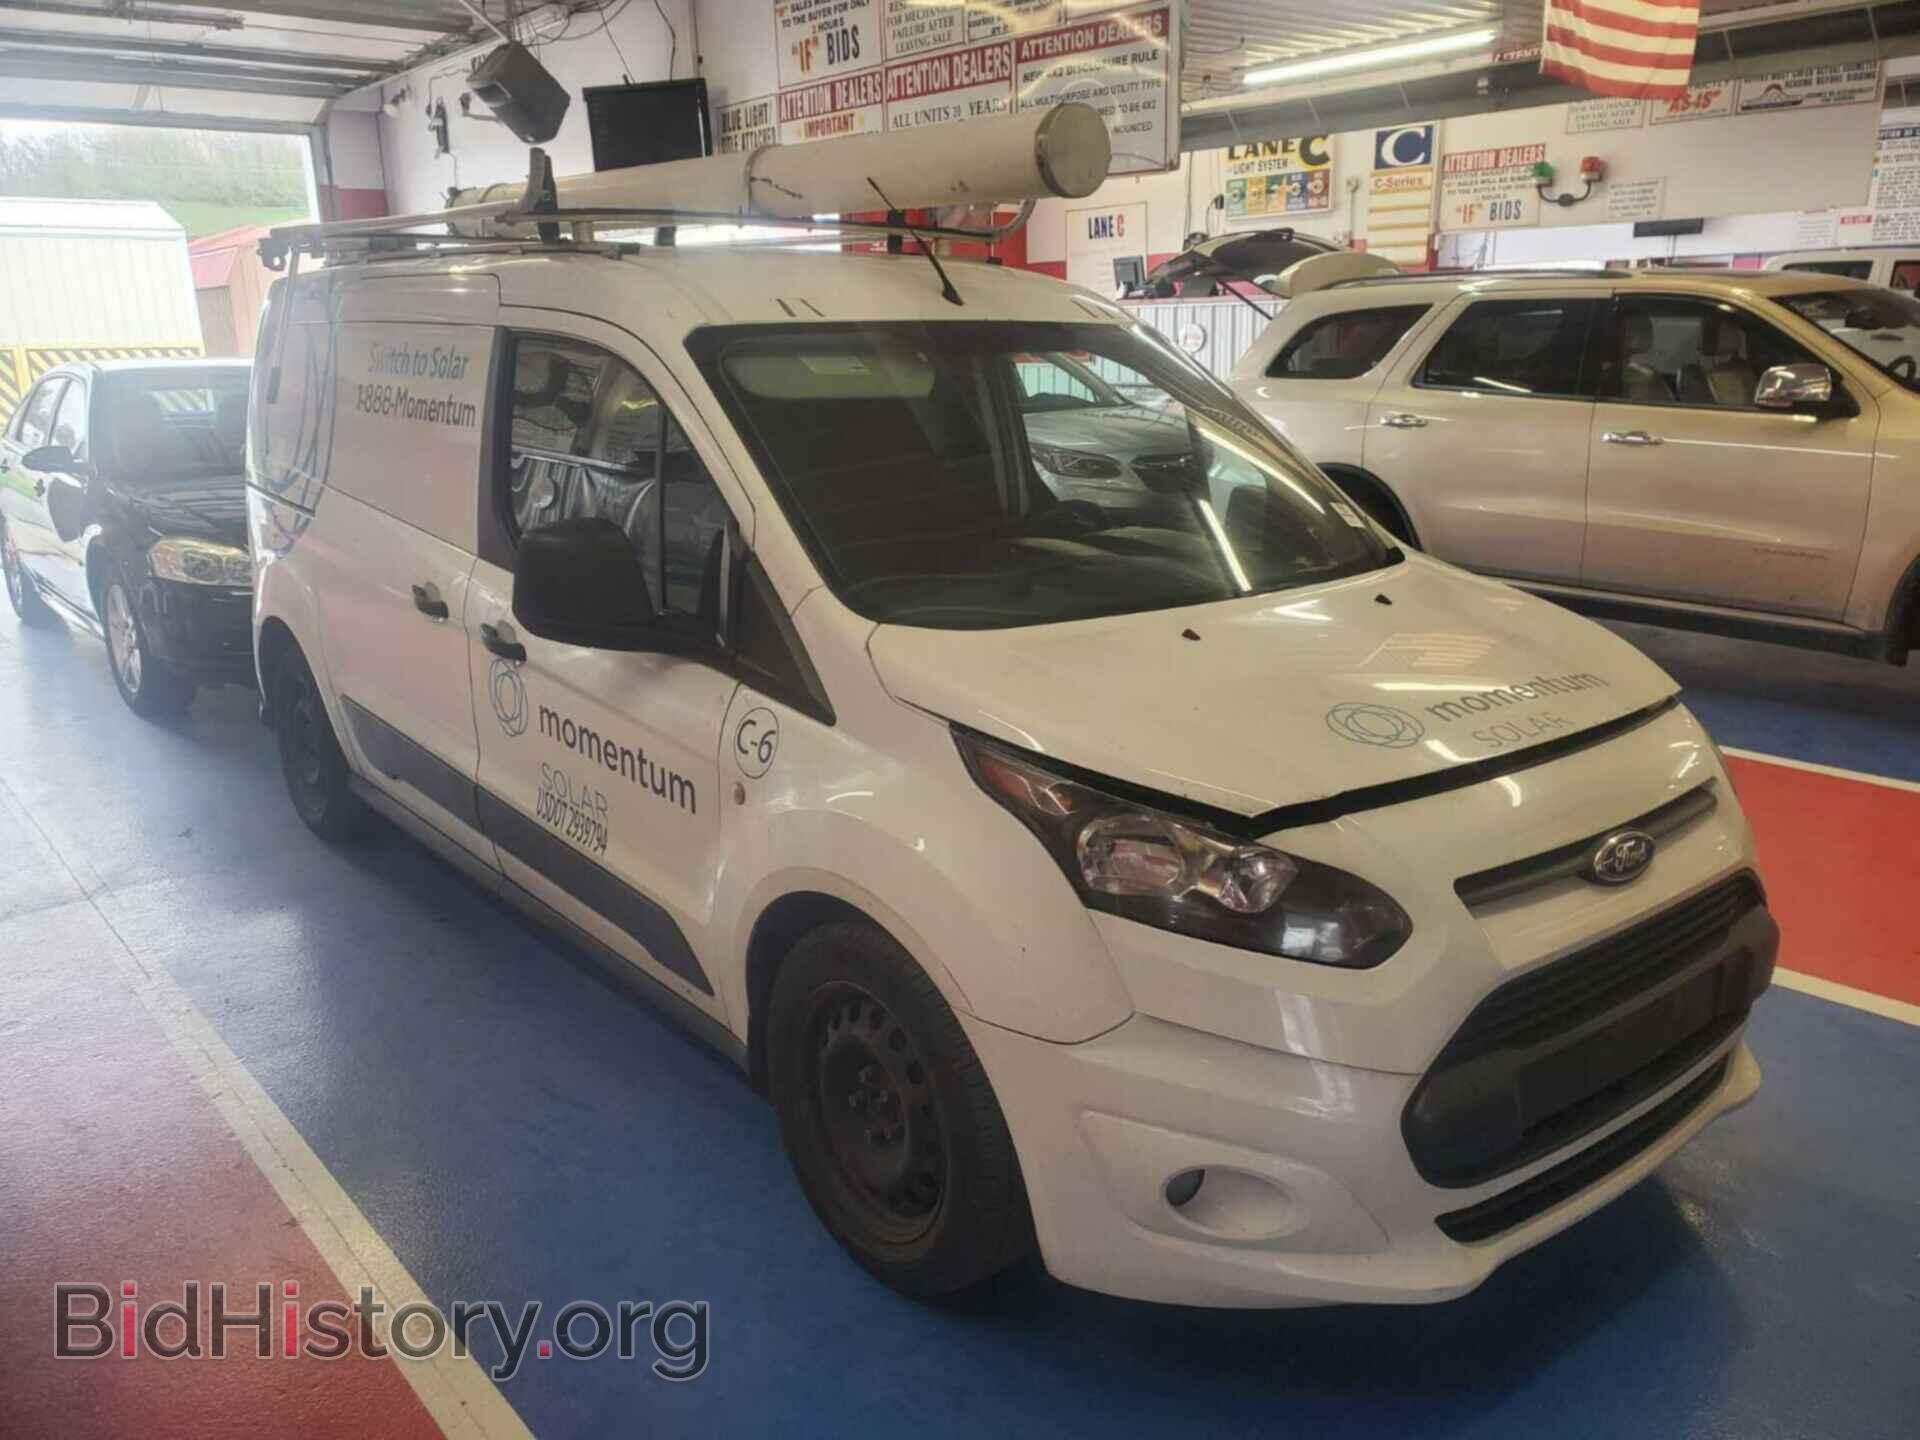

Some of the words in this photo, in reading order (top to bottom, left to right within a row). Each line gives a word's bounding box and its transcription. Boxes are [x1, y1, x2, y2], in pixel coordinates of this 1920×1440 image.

[826, 25, 860, 65] BIDS
[1021, 27, 1095, 61] ATTENTION
[1098, 14, 1163, 45] DEALERS
[887, 55, 950, 99] ATTENTION
[952, 43, 1011, 85] DEALERS
[1131, 49, 1159, 64] RULE
[781, 85, 832, 122] ATTENTION
[836, 72, 882, 111] DEALERS
[1092, 86, 1109, 97] AND
[1111, 81, 1141, 95] UTILITY
[1142, 79, 1162, 89] TYPE
[804, 113, 855, 137] IMPORTANT
[893, 109, 912, 128] ALL
[914, 104, 950, 125] UNITS
[1228, 137, 1297, 160] LANE
[1299, 134, 1331, 167] C
[1258, 158, 1288, 172] SYSTEM
[1381, 127, 1426, 167] C
[1444, 149, 1495, 172] ATTENTION
[1498, 144, 1545, 167] DEALERS
[1373, 175, 1424, 189] C-Series
[1088, 215, 1113, 239] LANE
[1115, 213, 1126, 238] C
[1489, 201, 1522, 221] BIDS
[368, 344, 411, 376] Switch
[413, 348, 427, 377] to
[430, 344, 469, 381] Solar
[1426, 671, 1609, 723] momentum
[737, 719, 777, 764] C-6
[1472, 711, 1570, 748] SOLAR
[538, 704, 697, 815] momentum
[540, 762, 609, 820] SOLAR
[536, 787, 569, 835] USDOT
[1599, 839, 1648, 873] Ford
